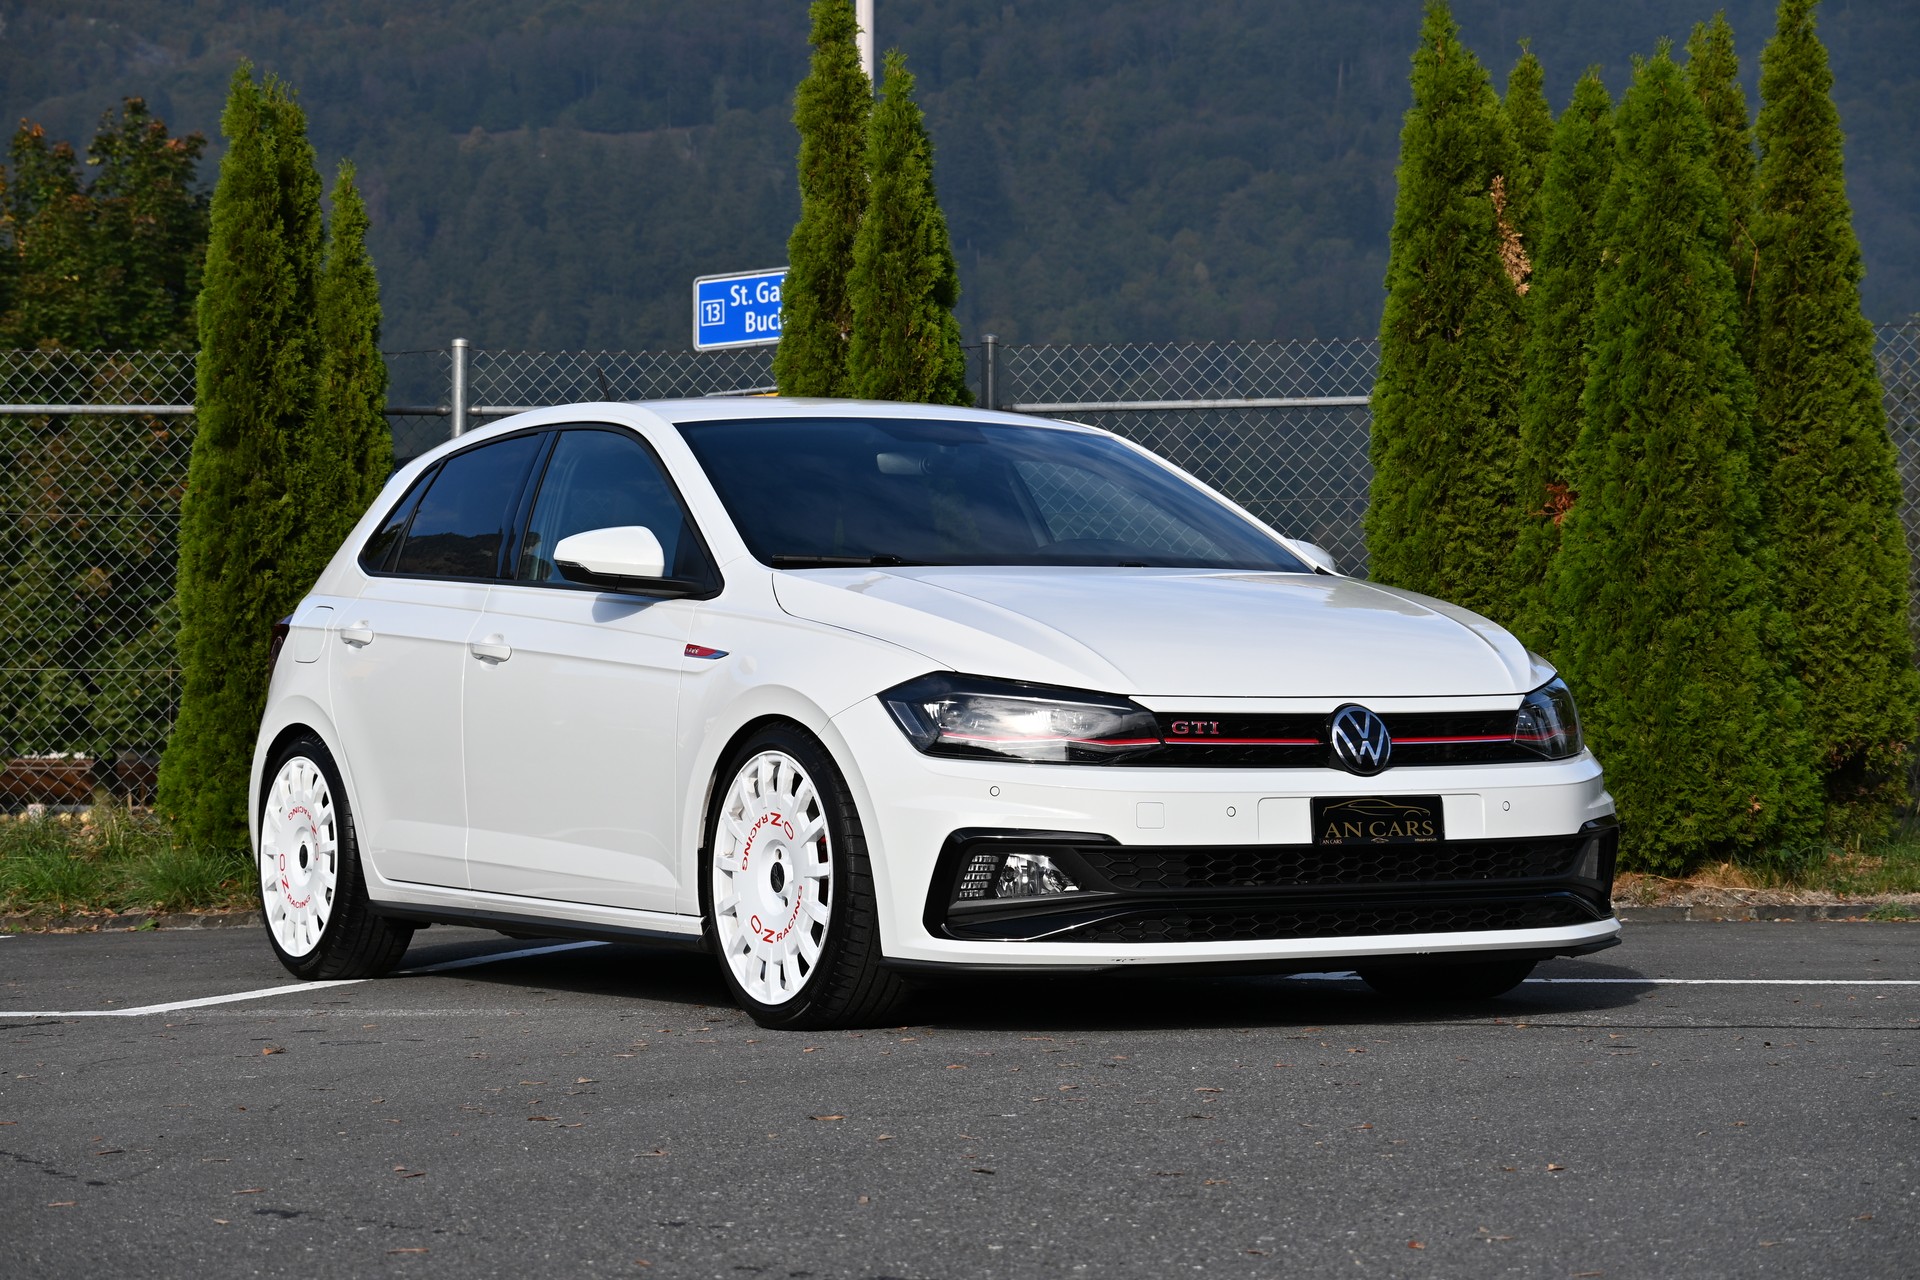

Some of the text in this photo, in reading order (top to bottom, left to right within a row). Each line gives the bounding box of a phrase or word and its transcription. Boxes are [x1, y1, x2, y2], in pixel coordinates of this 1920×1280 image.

[730, 279, 784, 307] St. Ga
[705, 303, 721, 322] 13
[1171, 720, 1220, 735] GTI
[1324, 820, 1434, 838] AN CARS
[742, 813, 769, 871] RACING
[776, 885, 803, 941] RACING
